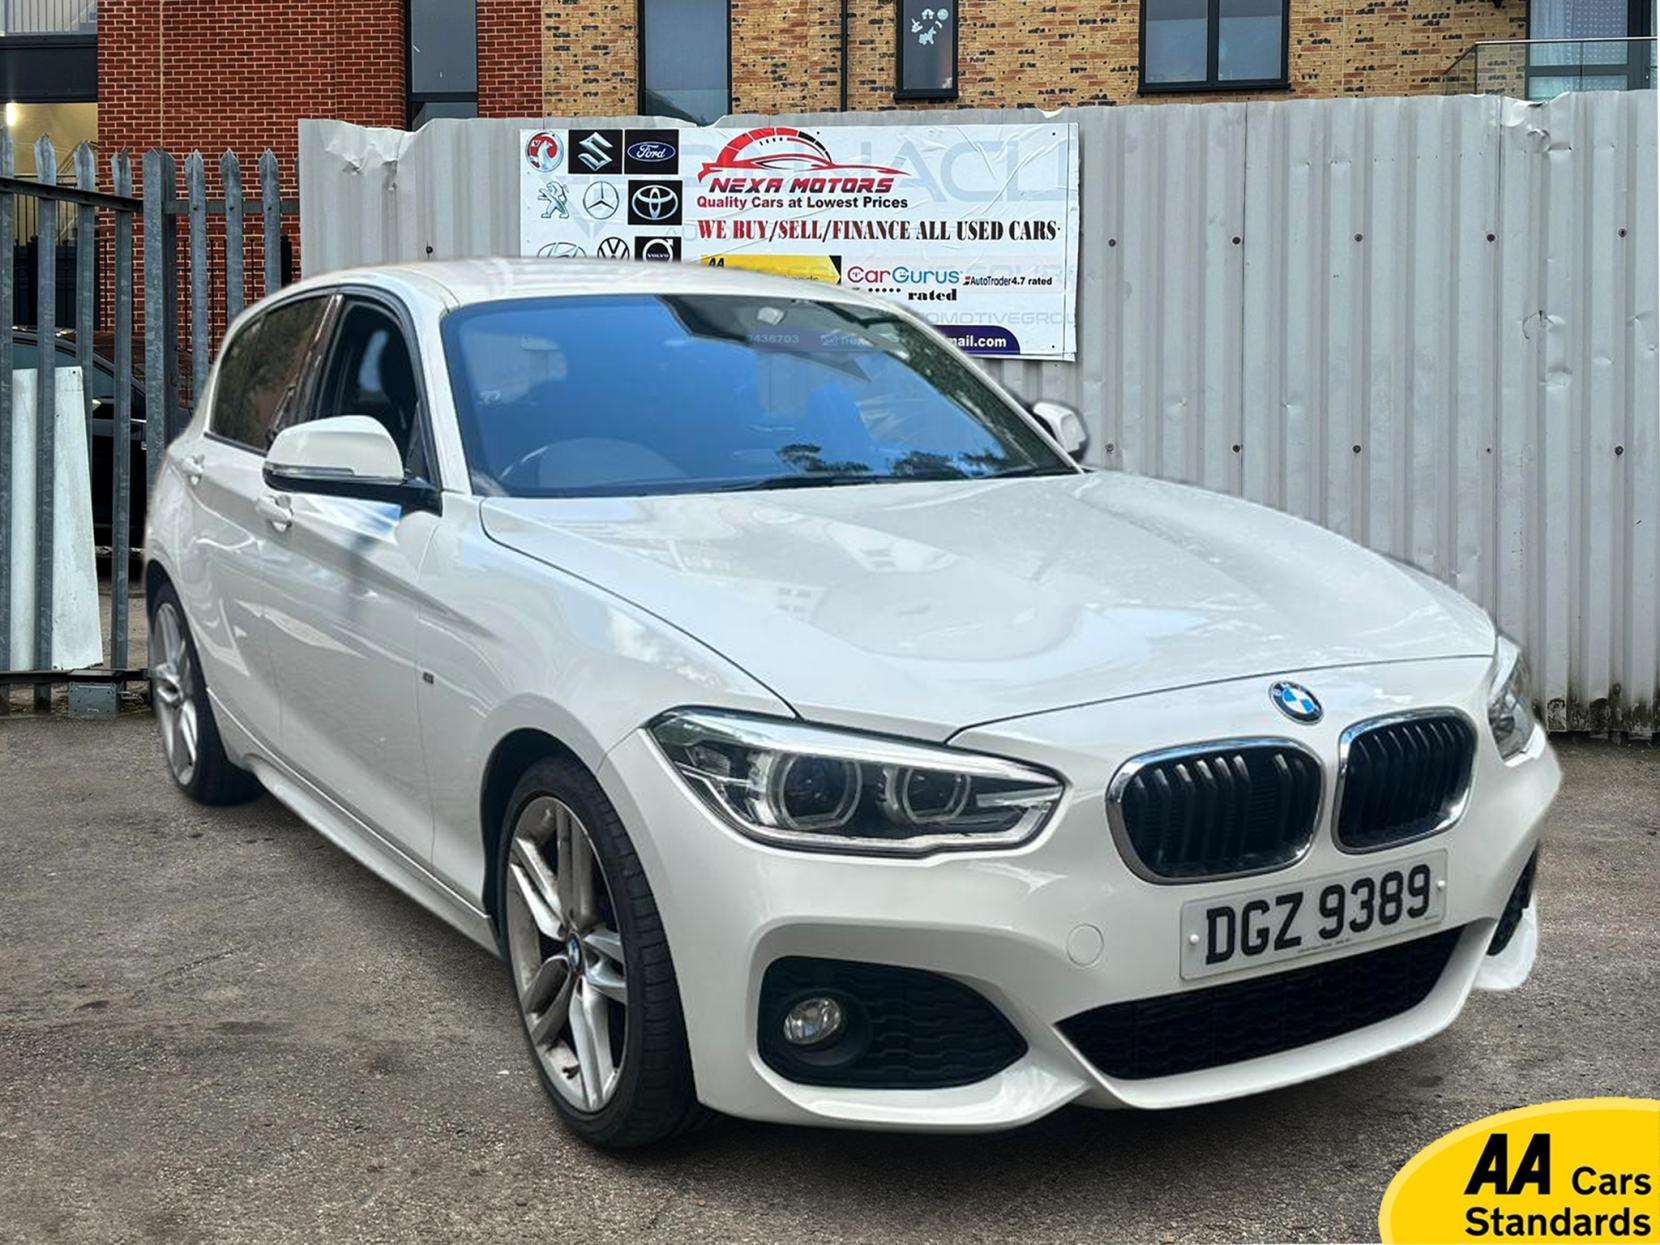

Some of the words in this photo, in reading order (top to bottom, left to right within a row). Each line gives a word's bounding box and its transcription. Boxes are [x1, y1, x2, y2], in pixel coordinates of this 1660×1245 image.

[636, 144, 666, 158] Ford
[708, 177, 783, 193] NEXA
[789, 177, 894, 193] MOTORS
[697, 195, 746, 210] Quality
[752, 196, 784, 208] Cars
[788, 196, 803, 208] at
[807, 196, 858, 208] Lowest
[863, 196, 908, 208] Prices
[697, 219, 727, 240] WE
[915, 219, 951, 241] ALL
[956, 219, 1003, 241] USED
[1008, 219, 1057, 241] CARS
[847, 266, 960, 284] CarGurus
[1027, 276, 1053, 286] rated
[908, 288, 957, 301] rated
[1206, 891, 1304, 965] DGZ
[1318, 864, 1431, 940] 9389
